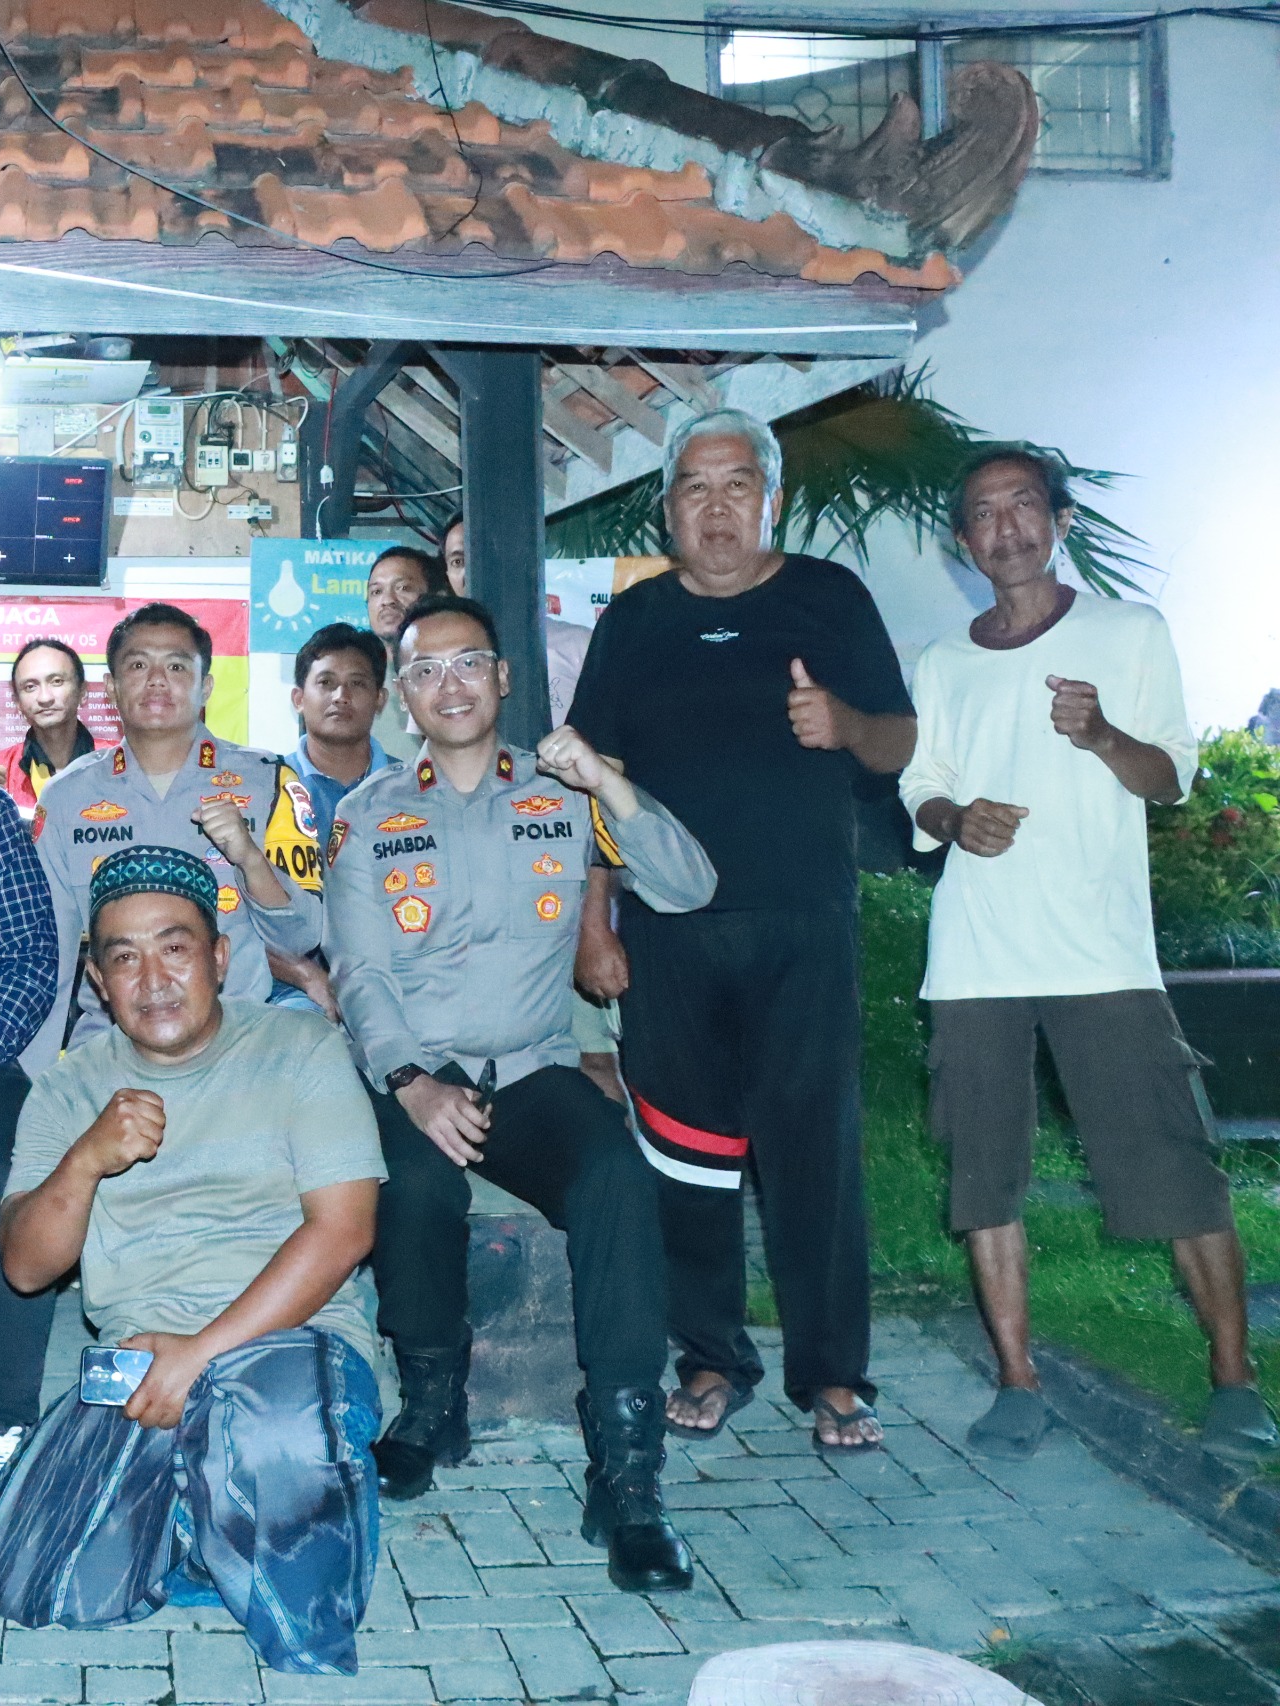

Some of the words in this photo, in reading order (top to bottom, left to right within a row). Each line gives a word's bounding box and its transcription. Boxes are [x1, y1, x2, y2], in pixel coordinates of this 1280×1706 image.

[304, 550, 378, 565] MATIKA
[590, 593, 609, 605] CALL
[3, 634, 23, 646] RT
[78, 634, 98, 647] 05
[73, 825, 134, 844] ROVAN
[511, 821, 573, 841] POLRI
[372, 834, 438, 860] SHABDA
